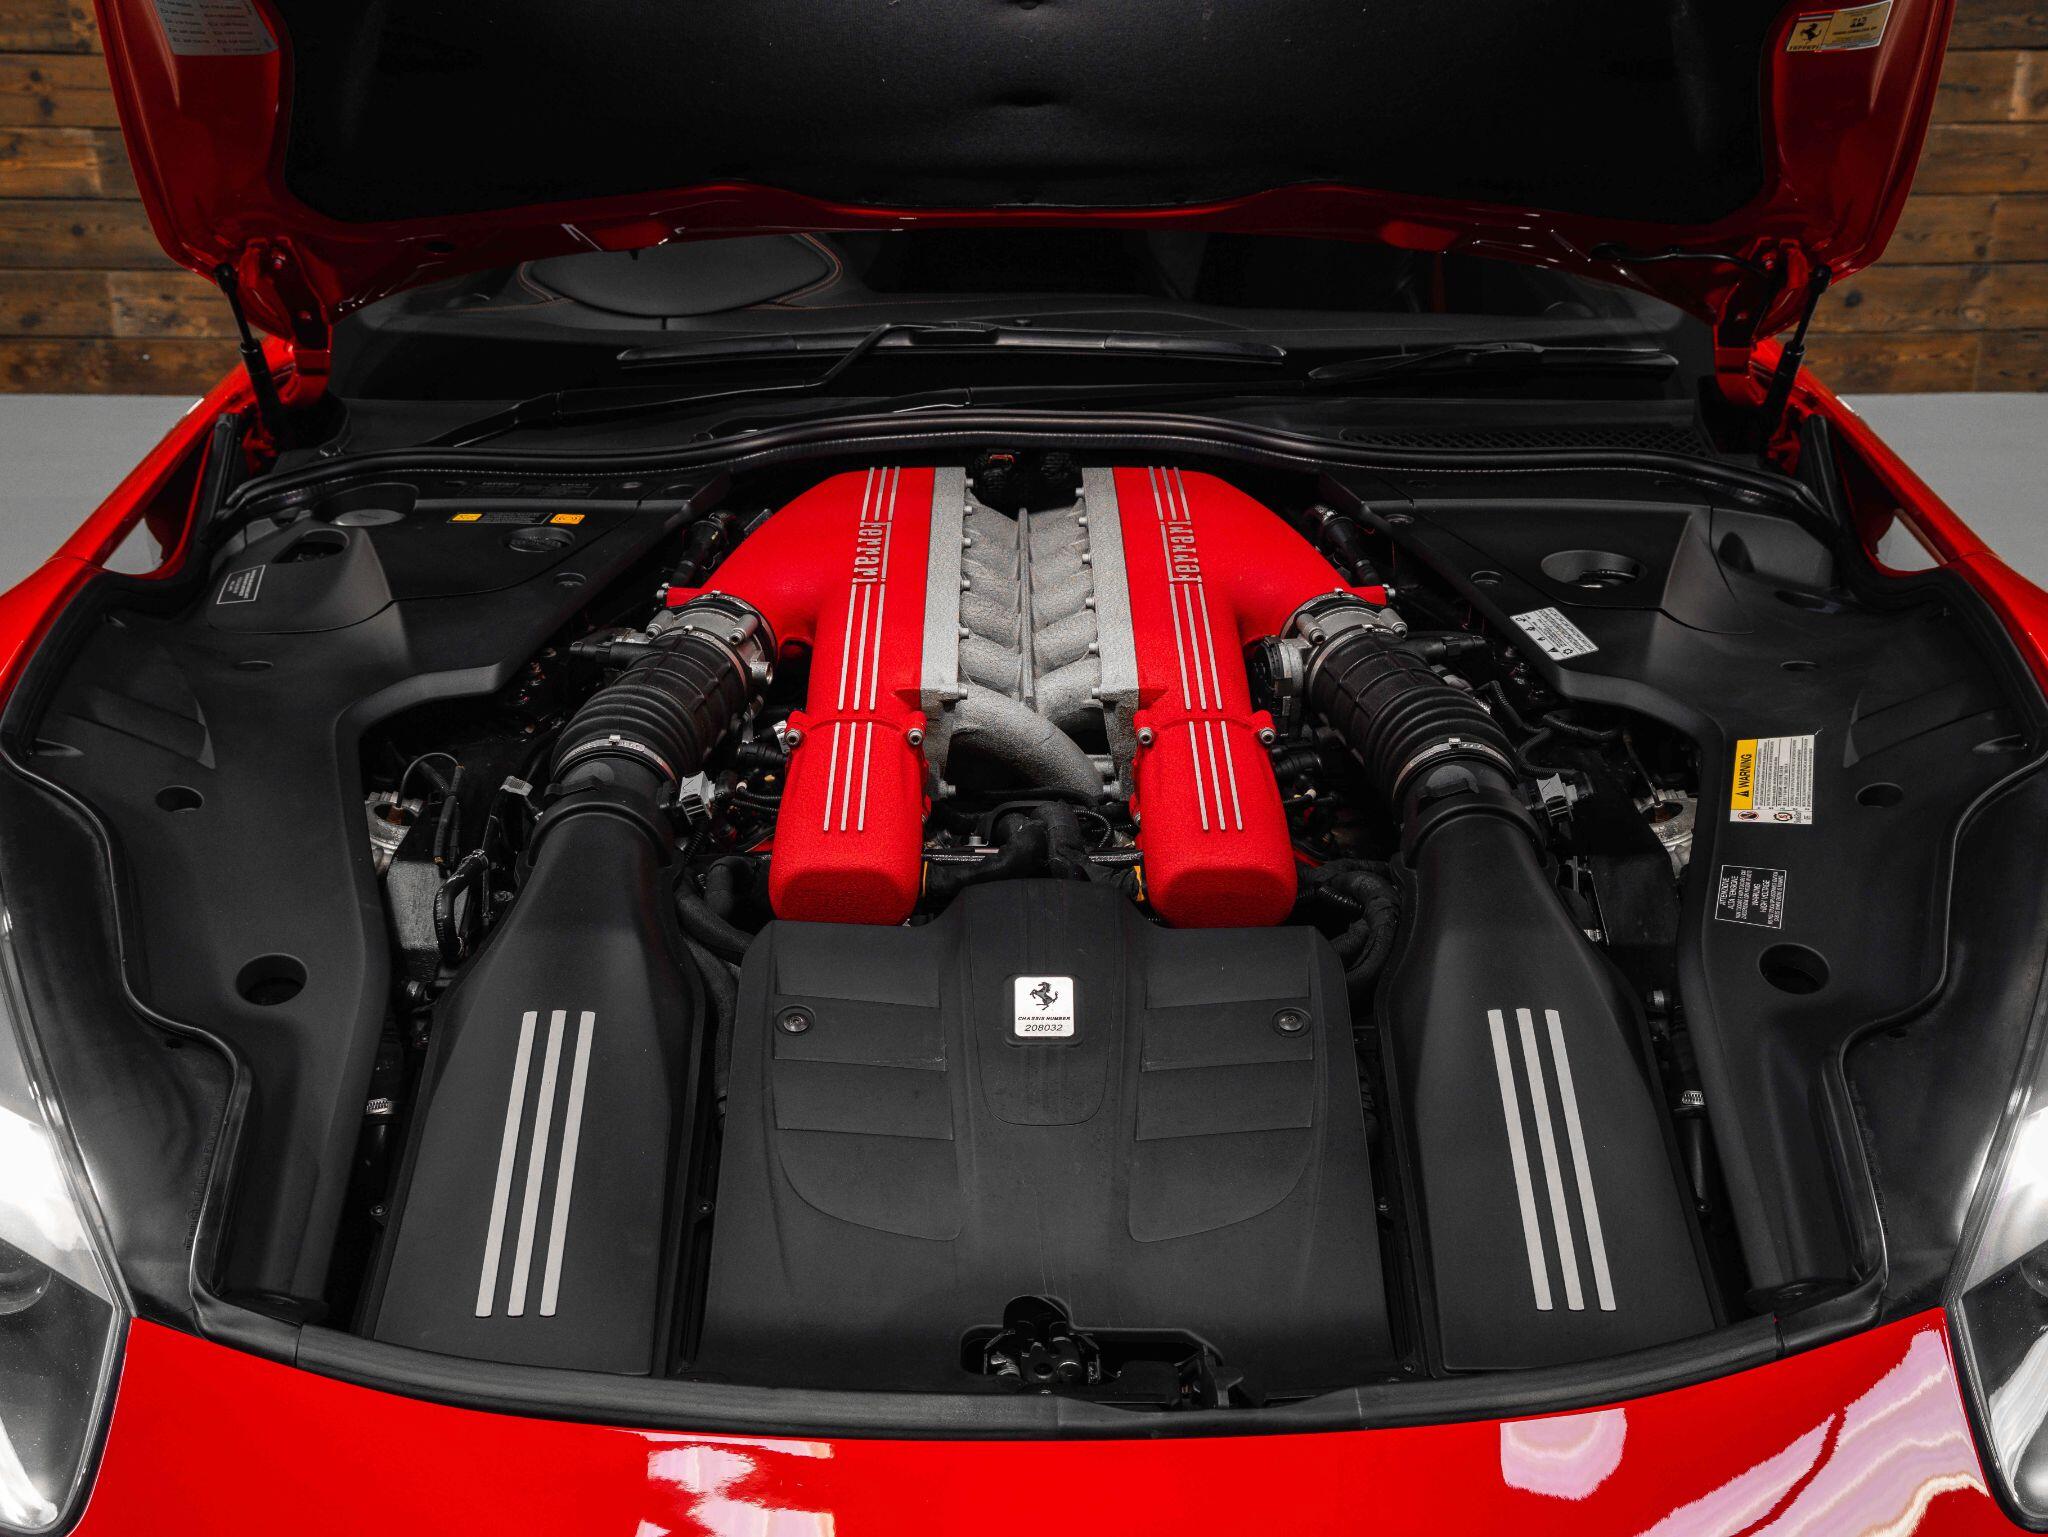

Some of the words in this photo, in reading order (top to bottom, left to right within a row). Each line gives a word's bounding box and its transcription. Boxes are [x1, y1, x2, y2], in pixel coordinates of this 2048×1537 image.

[852, 521, 892, 583] Ferrari
[1160, 520, 1203, 583] Ferrari
[1739, 753, 1752, 789] WARNING
[1024, 1024, 1063, 1032] 208032
